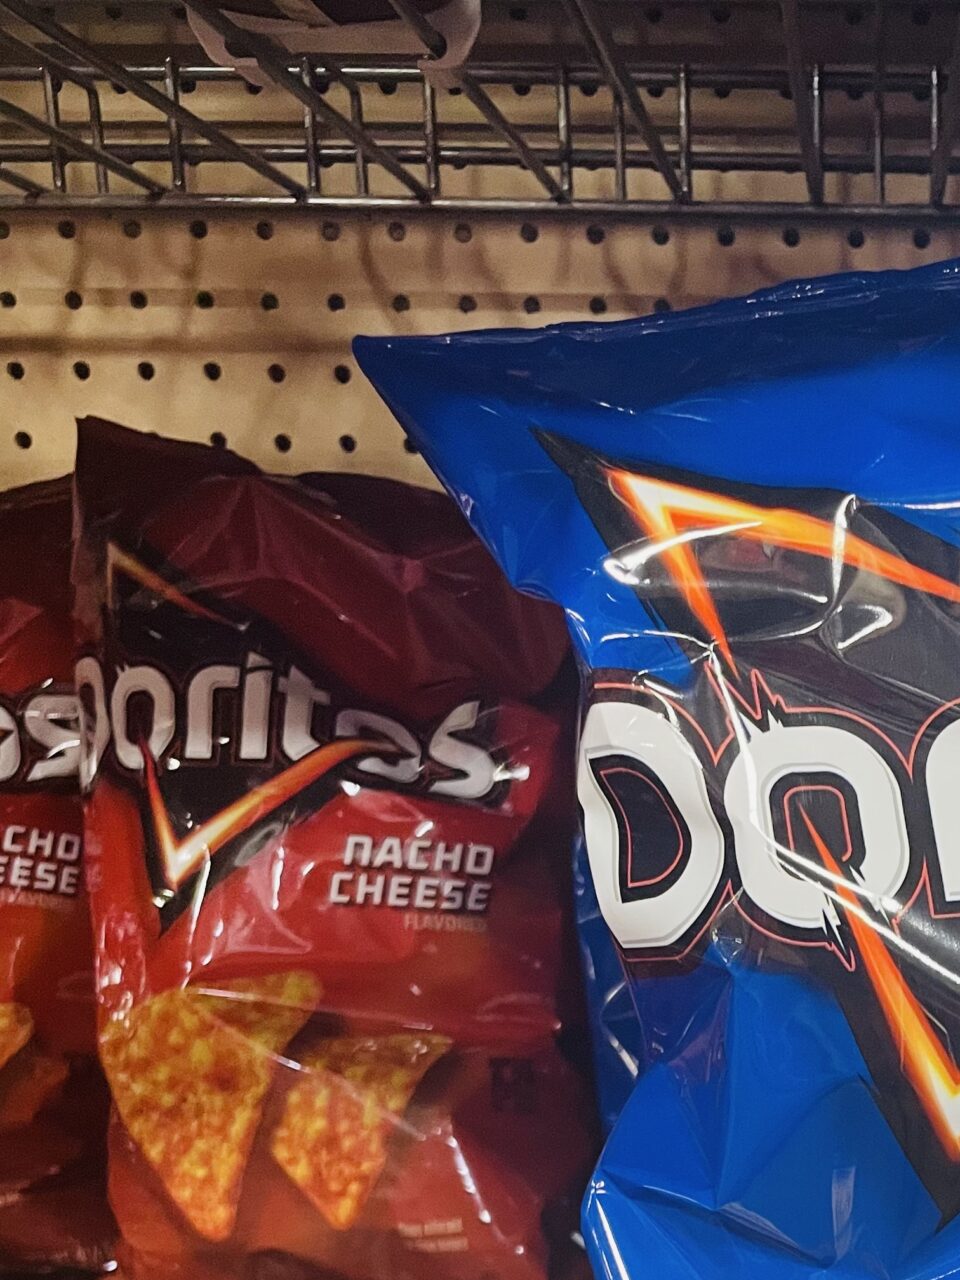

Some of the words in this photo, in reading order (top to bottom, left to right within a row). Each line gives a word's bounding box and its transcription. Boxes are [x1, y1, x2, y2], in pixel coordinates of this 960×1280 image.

[2, 824, 81, 862] CHO
[343, 834, 495, 876] NACHO
[330, 871, 492, 911] CHEESE
